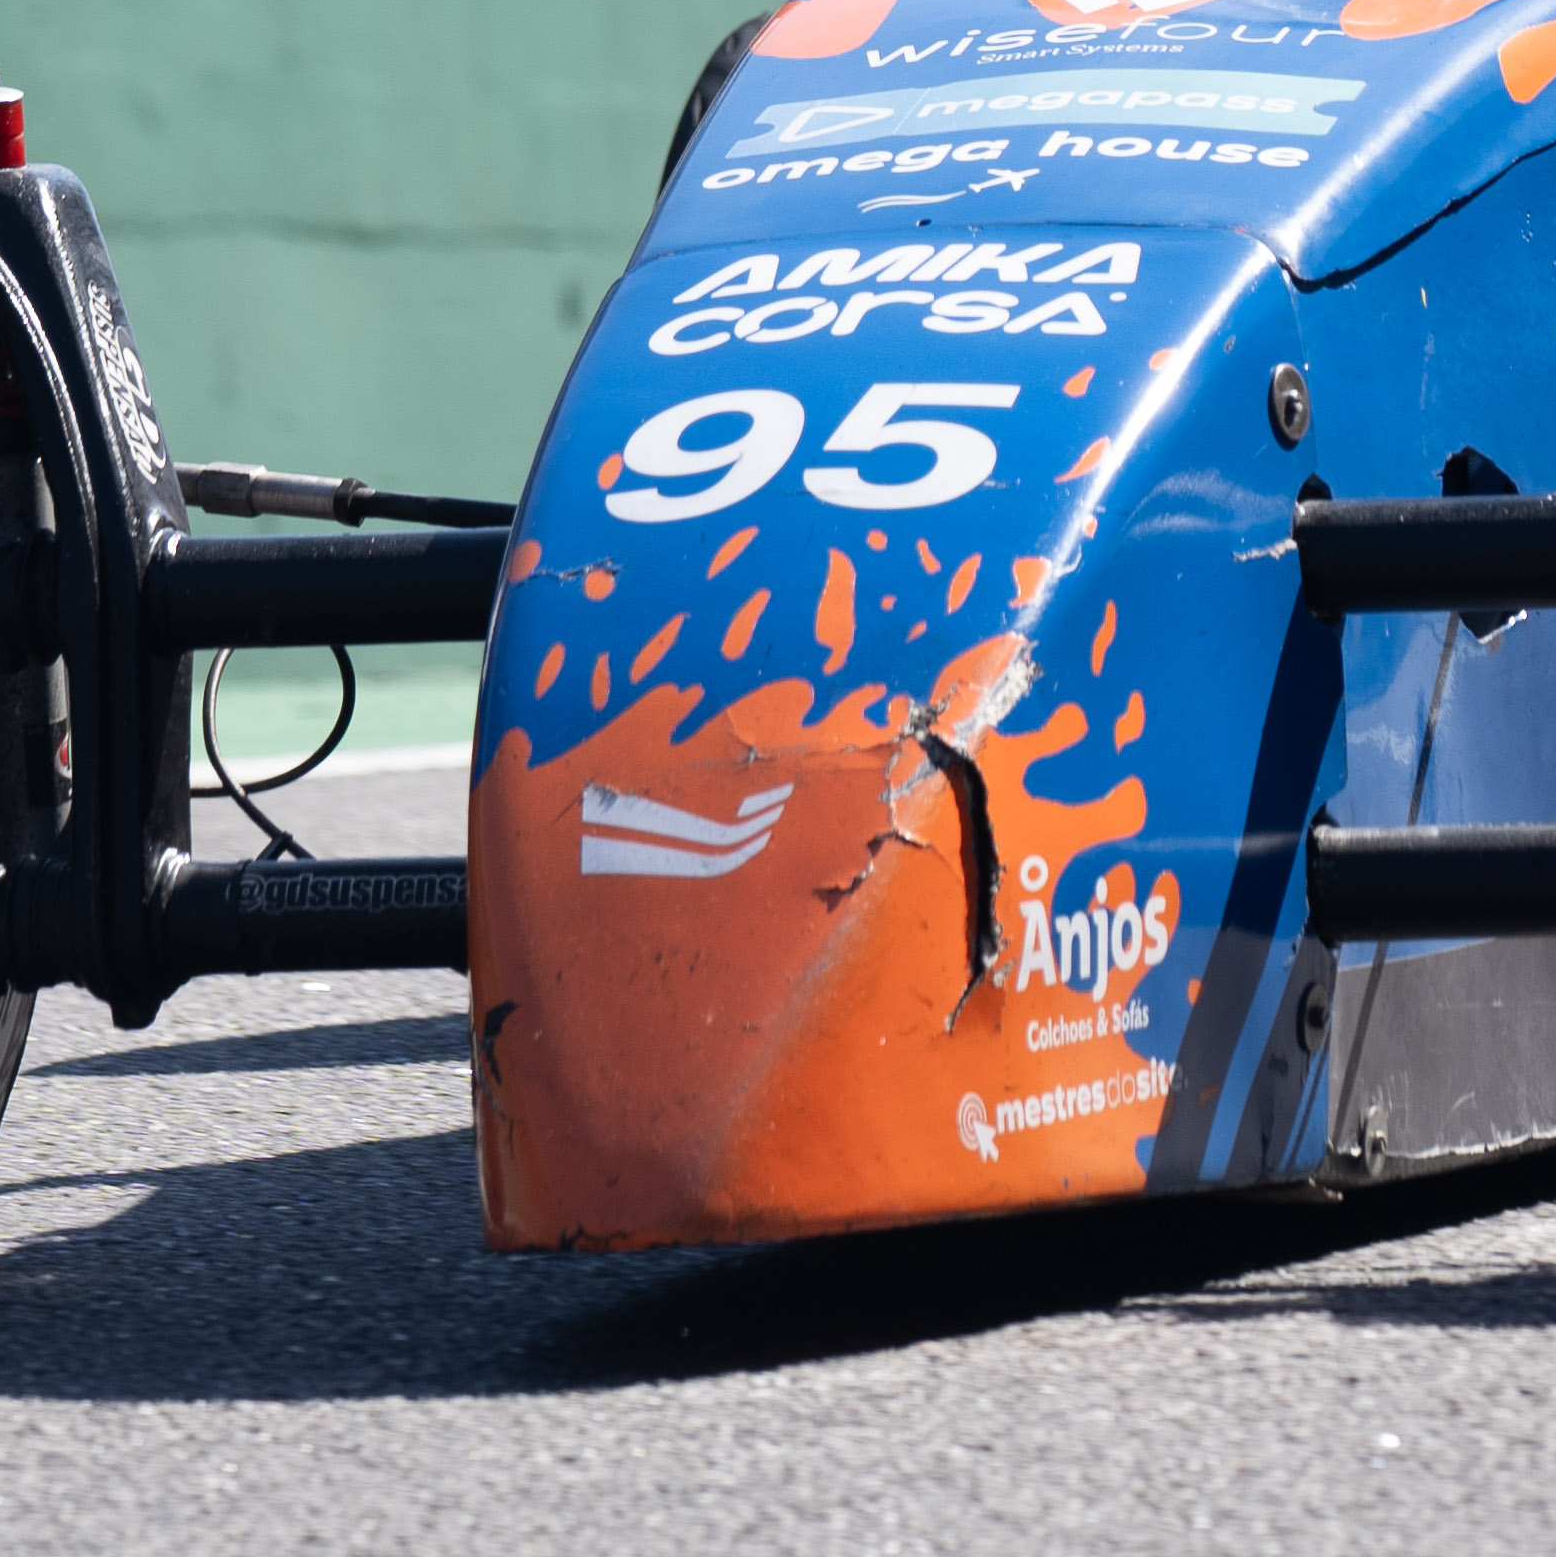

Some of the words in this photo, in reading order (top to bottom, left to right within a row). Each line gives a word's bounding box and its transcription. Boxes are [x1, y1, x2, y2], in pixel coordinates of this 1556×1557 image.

[865, 14, 1346, 70] wisefour
[976, 45, 1061, 66] Smart
[1065, 42, 1185, 58] Systems
[915, 89, 1301, 124] megapass
[701, 138, 1010, 190] omega
[1037, 130, 1311, 168] house
[672, 241, 1143, 305] AMIKA
[603, 382, 1023, 523] 95
[1096, 1006, 1109, 1038] &
[1111, 996, 1150, 1034] Sofás
